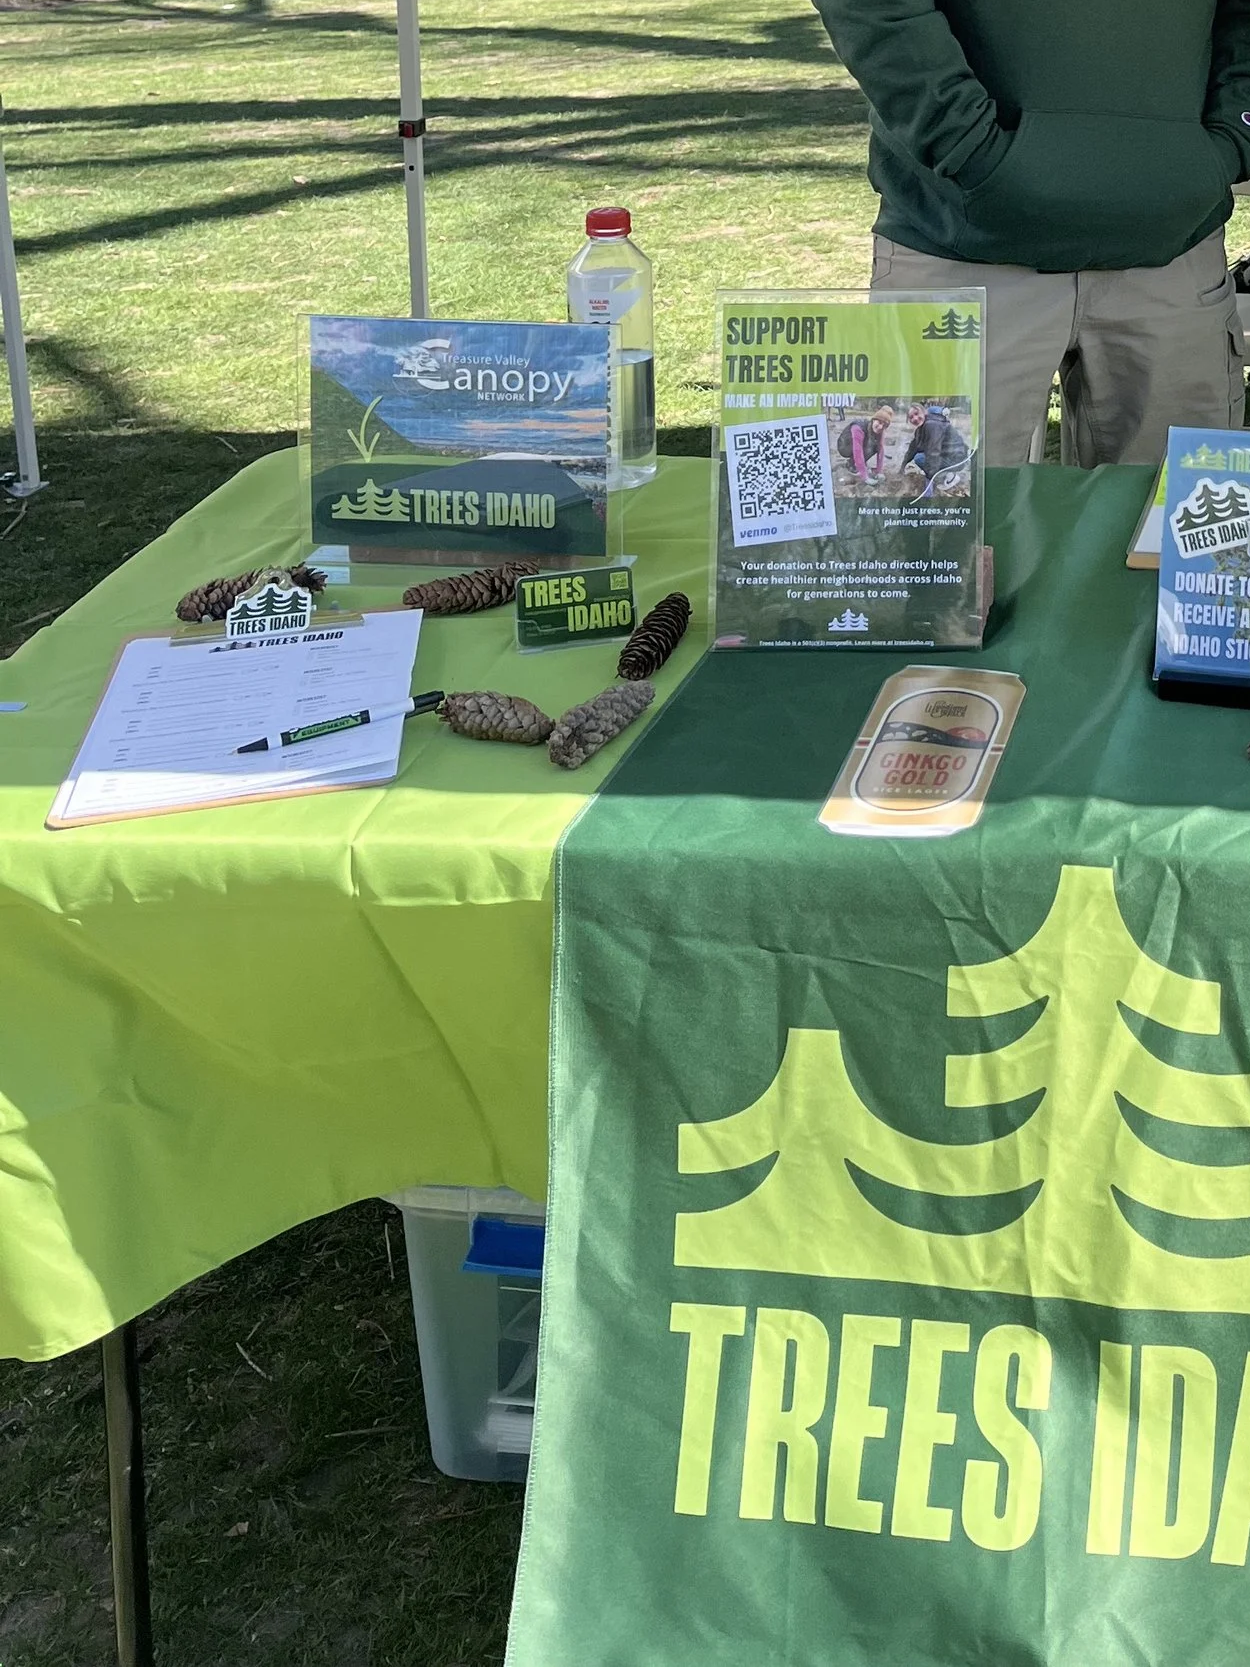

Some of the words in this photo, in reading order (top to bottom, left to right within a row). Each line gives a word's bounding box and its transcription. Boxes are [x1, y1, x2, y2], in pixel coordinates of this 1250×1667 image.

[727, 317, 828, 345] SUPPORT
[442, 352, 491, 366] Treasure
[495, 354, 531, 368] Valley
[726, 354, 793, 383] TREES
[802, 353, 869, 382] IDAHO
[477, 391, 525, 401] NETWORK
[724, 394, 756, 408] MAKE
[759, 394, 773, 408] AN
[777, 393, 817, 407] IMPACT
[820, 393, 855, 407] TODAY
[410, 489, 479, 526] TREES
[486, 492, 556, 529] IDAHO
[858, 506, 879, 514] More
[881, 506, 900, 514] than
[901, 506, 918, 516] just
[883, 518, 918, 527] planting
[919, 518, 968, 527] community.
[740, 527, 778, 538] venmo
[1180, 527, 1217, 554] TREES
[1218, 519, 1250, 545] IDAH
[740, 561, 764, 570] Your
[766, 560, 812, 570] donation
[815, 561, 826, 570] to
[828, 560, 856, 569] Trees
[858, 560, 887, 569] Idaho
[889, 560, 928, 571] directly
[931, 560, 958, 570] helps
[736, 576, 768, 584] create
[771, 575, 817, 584] healthier
[820, 575, 896, 586] neighborhoods
[933, 574, 962, 583] Idaho
[1175, 571, 1234, 595] DONATE
[521, 576, 587, 608] TREES
[786, 589, 801, 598] for
[803, 589, 864, 600] generations
[867, 589, 878, 598] to
[880, 590, 911, 598] come.
[567, 599, 632, 632] IDAHO
[1174, 602, 1235, 627] RECEIVE
[1240, 608, 1250, 629] A
[230, 619, 265, 636] TREES
[269, 614, 306, 631] IDAHO
[258, 636, 299, 648] TREES
[302, 631, 344, 643] IDAHO
[1173, 634, 1221, 658] IDAHO
[302, 719, 350, 736] EQUIPMENT
[880, 753, 967, 770] GINKGO
[884, 769, 950, 786] GOLD
[873, 786, 901, 794] RICE
[907, 787, 949, 795] LAGER
[670, 1302, 1053, 1552] TREES
